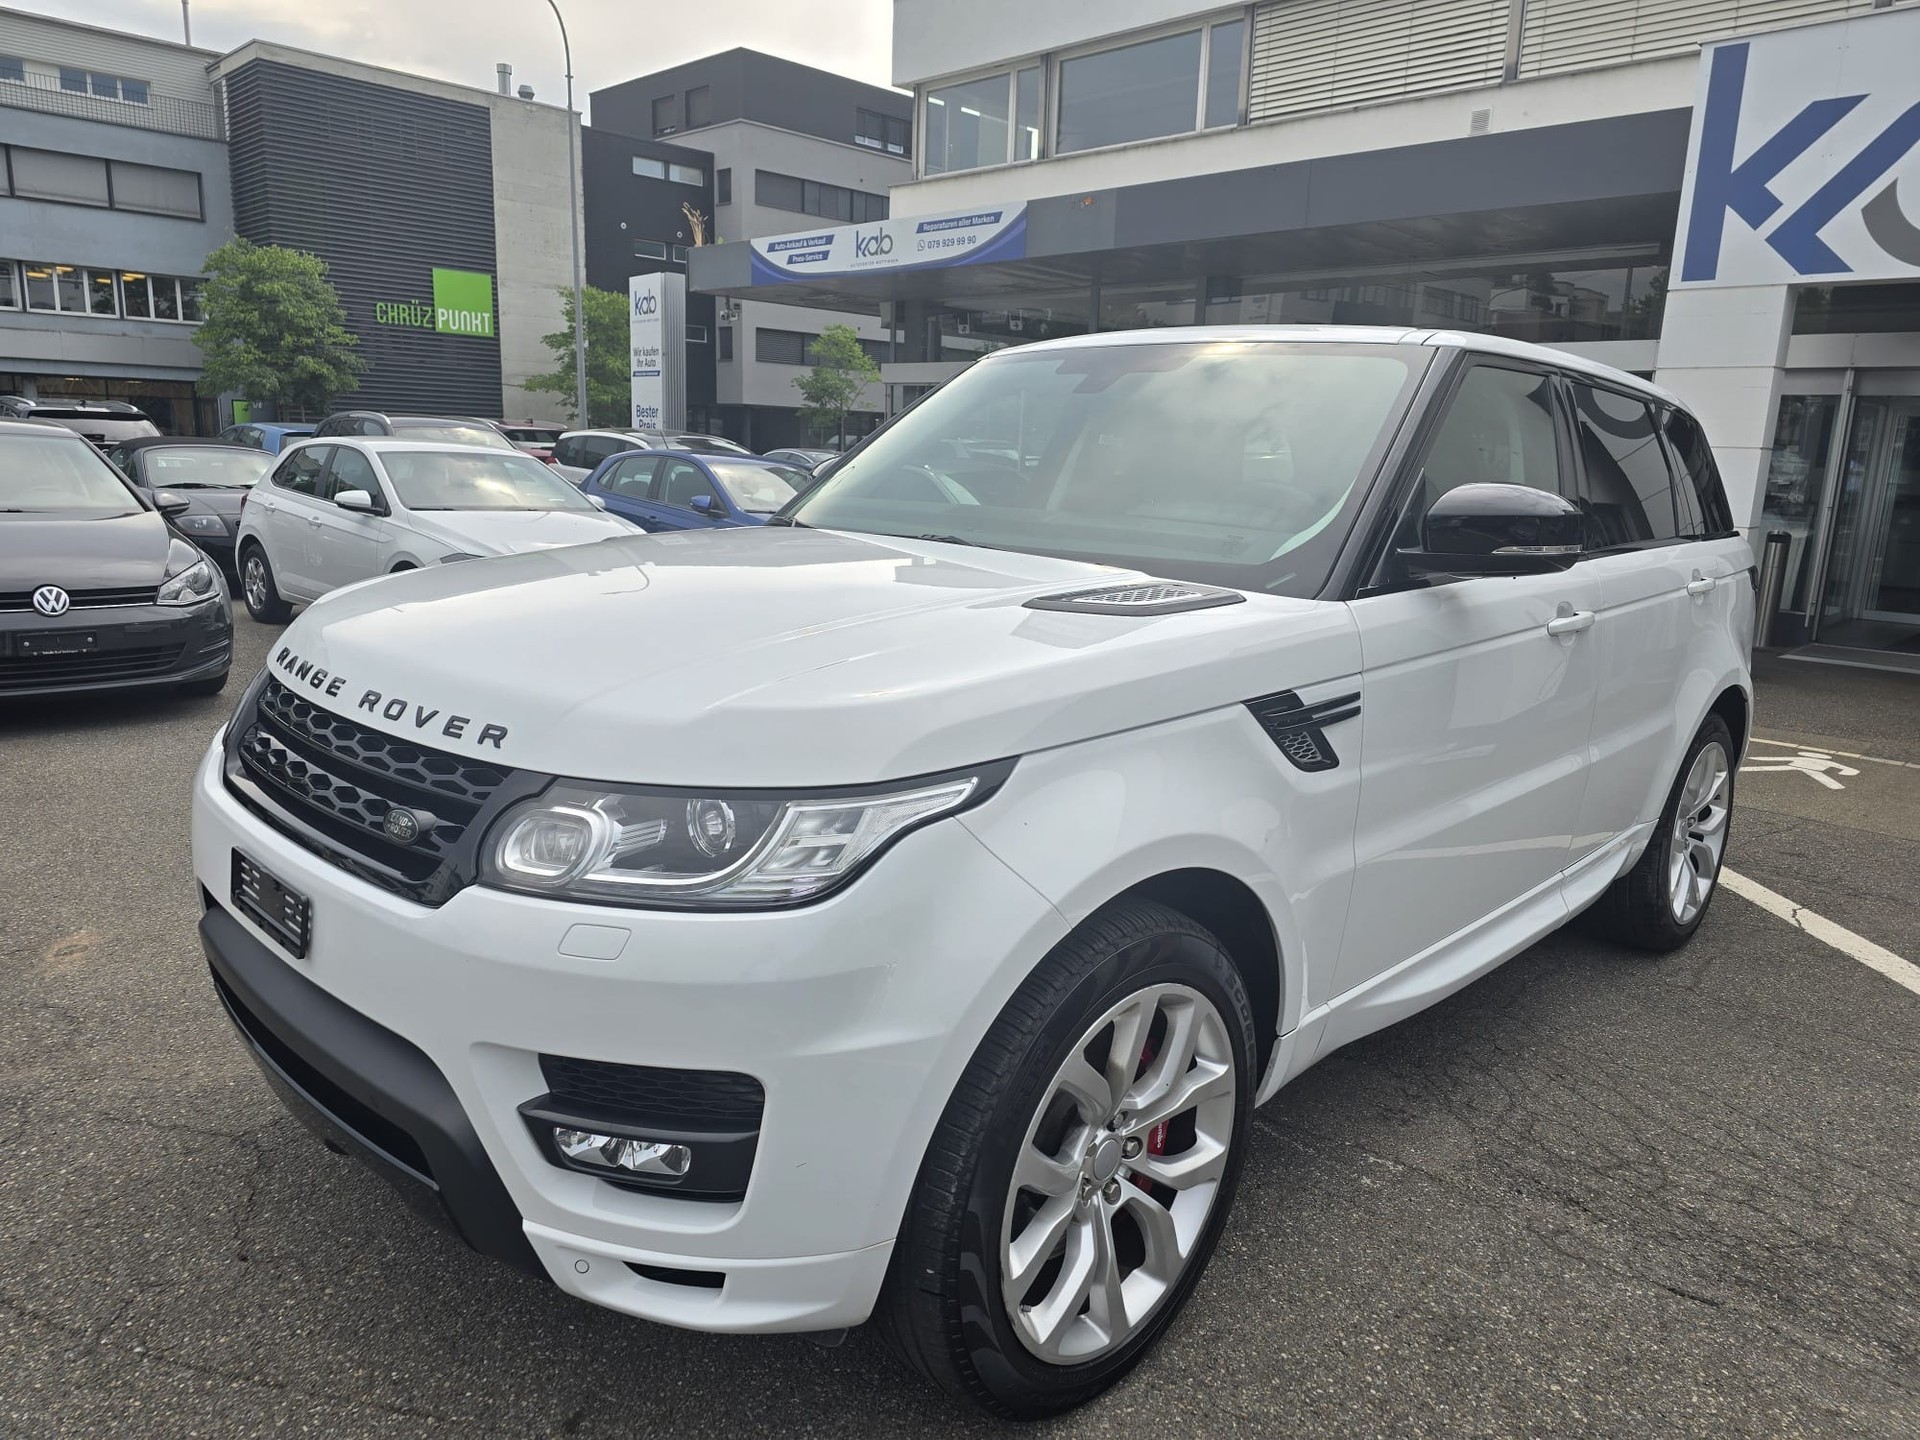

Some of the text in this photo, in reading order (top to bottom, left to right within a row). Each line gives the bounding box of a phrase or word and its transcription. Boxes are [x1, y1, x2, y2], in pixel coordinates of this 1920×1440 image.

[922, 215, 995, 231] Reparaturen aller Marken
[856, 227, 893, 258] kab
[927, 235, 977, 249] 079 929 99 90
[634, 288, 657, 316] kab
[375, 299, 490, 333] CHRÜZ PUNKT
[633, 345, 659, 357] Wir kaufen
[644, 357, 656, 367] Auto
[636, 404, 659, 418] Bester
[276, 646, 508, 750] RANGE ROVER
